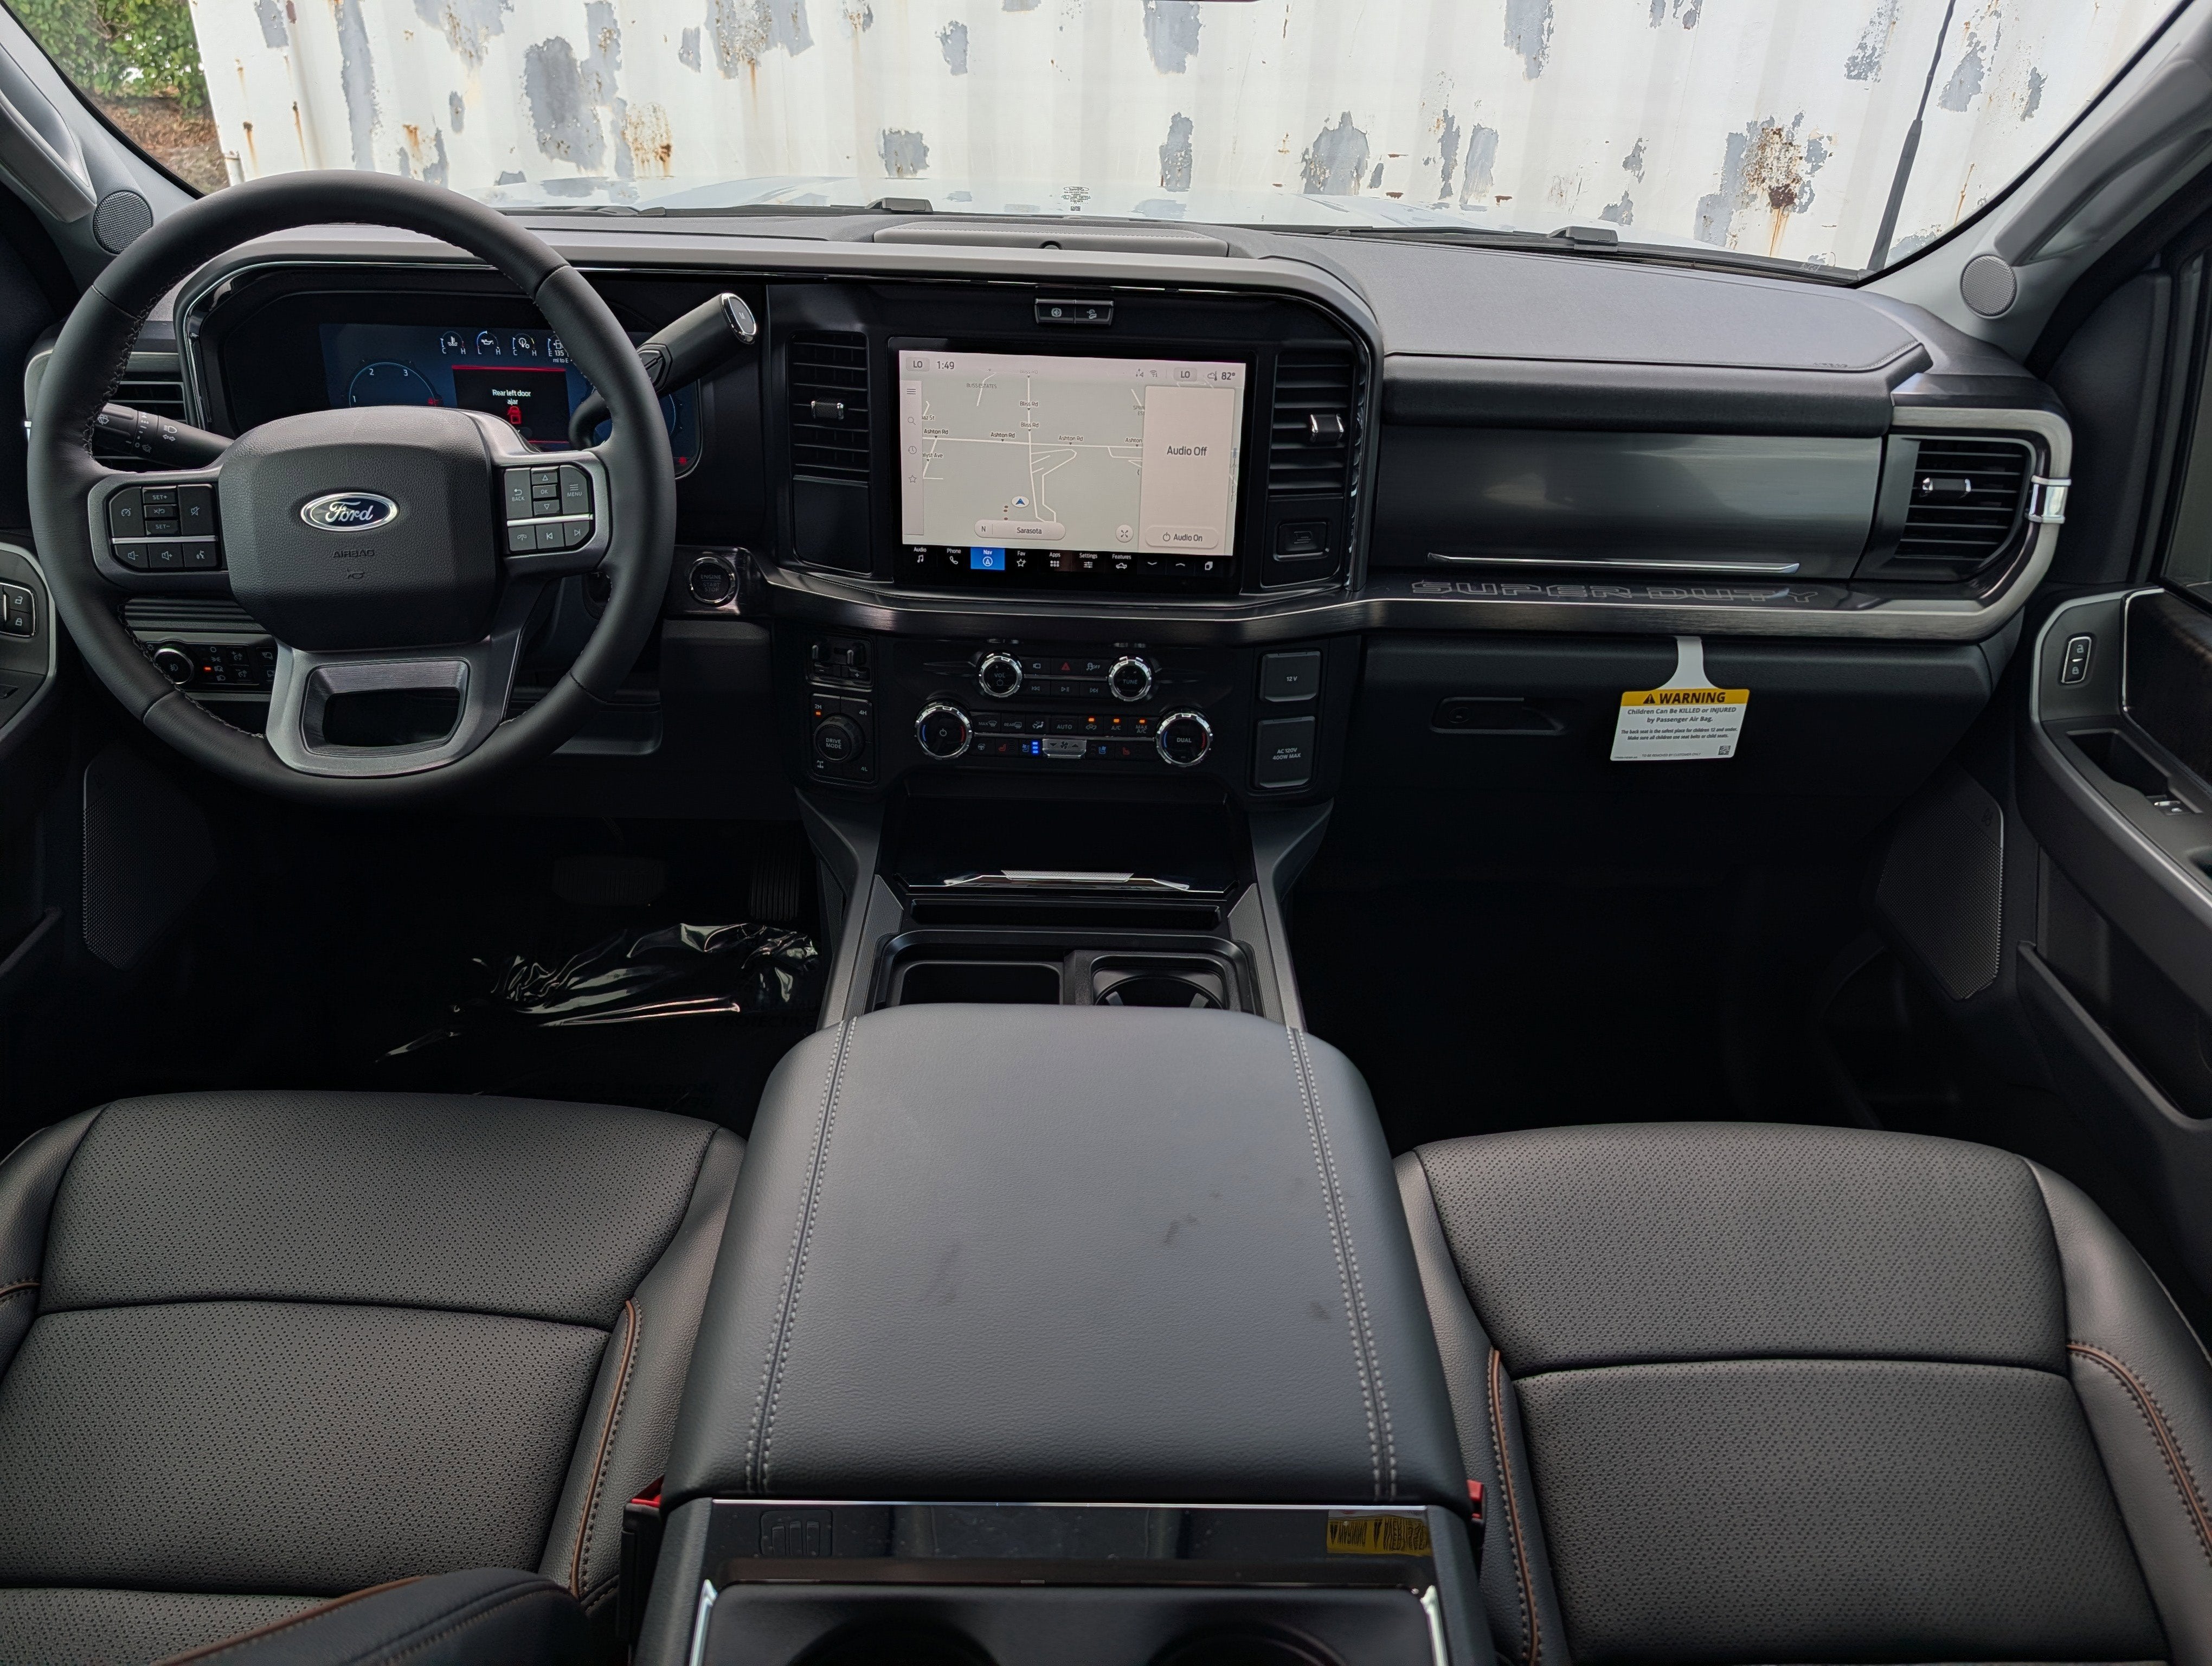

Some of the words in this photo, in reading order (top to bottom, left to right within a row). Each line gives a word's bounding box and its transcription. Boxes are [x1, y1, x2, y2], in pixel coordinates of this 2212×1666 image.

[937, 361, 955, 369] 1:49
[1167, 445, 1192, 456] Audio
[1193, 446, 1208, 456] Off
[325, 501, 374, 522] Ford
[333, 549, 375, 558] AIRBAG
[1411, 580, 1632, 599] SUPER
[1646, 587, 1819, 603] DUTY
[1659, 691, 1726, 704] WARNING
